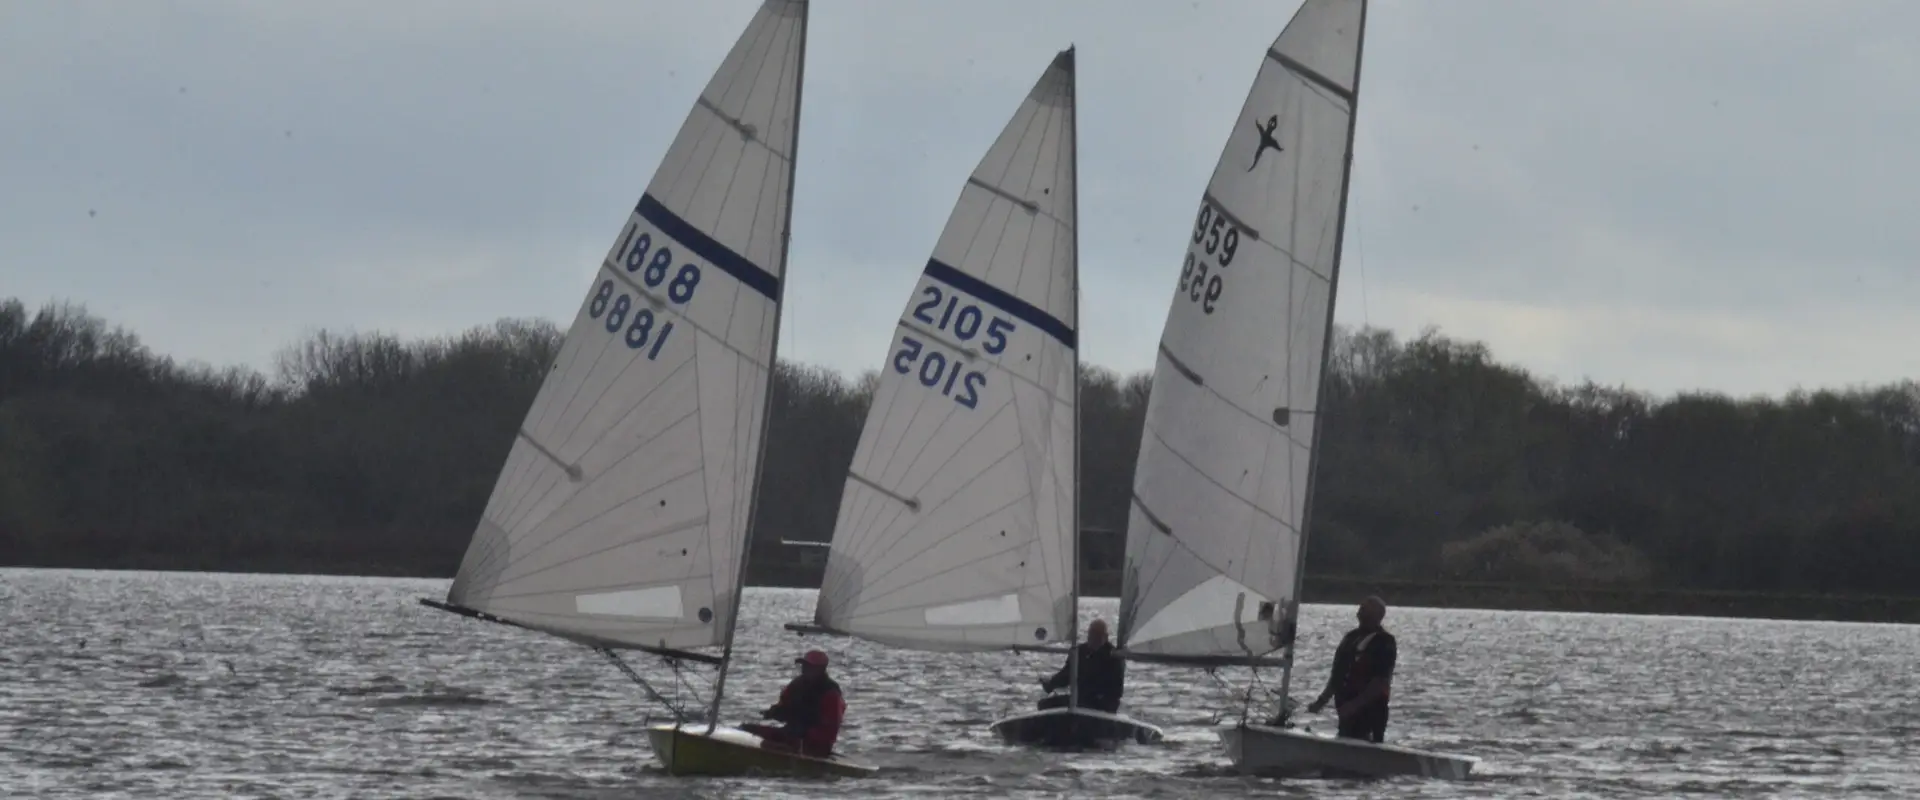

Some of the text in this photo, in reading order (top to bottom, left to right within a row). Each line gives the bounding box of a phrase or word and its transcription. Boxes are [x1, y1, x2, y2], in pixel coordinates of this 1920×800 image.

[616, 222, 701, 304] 1888
[1193, 204, 1239, 268] 959
[912, 286, 1016, 355] 2105
